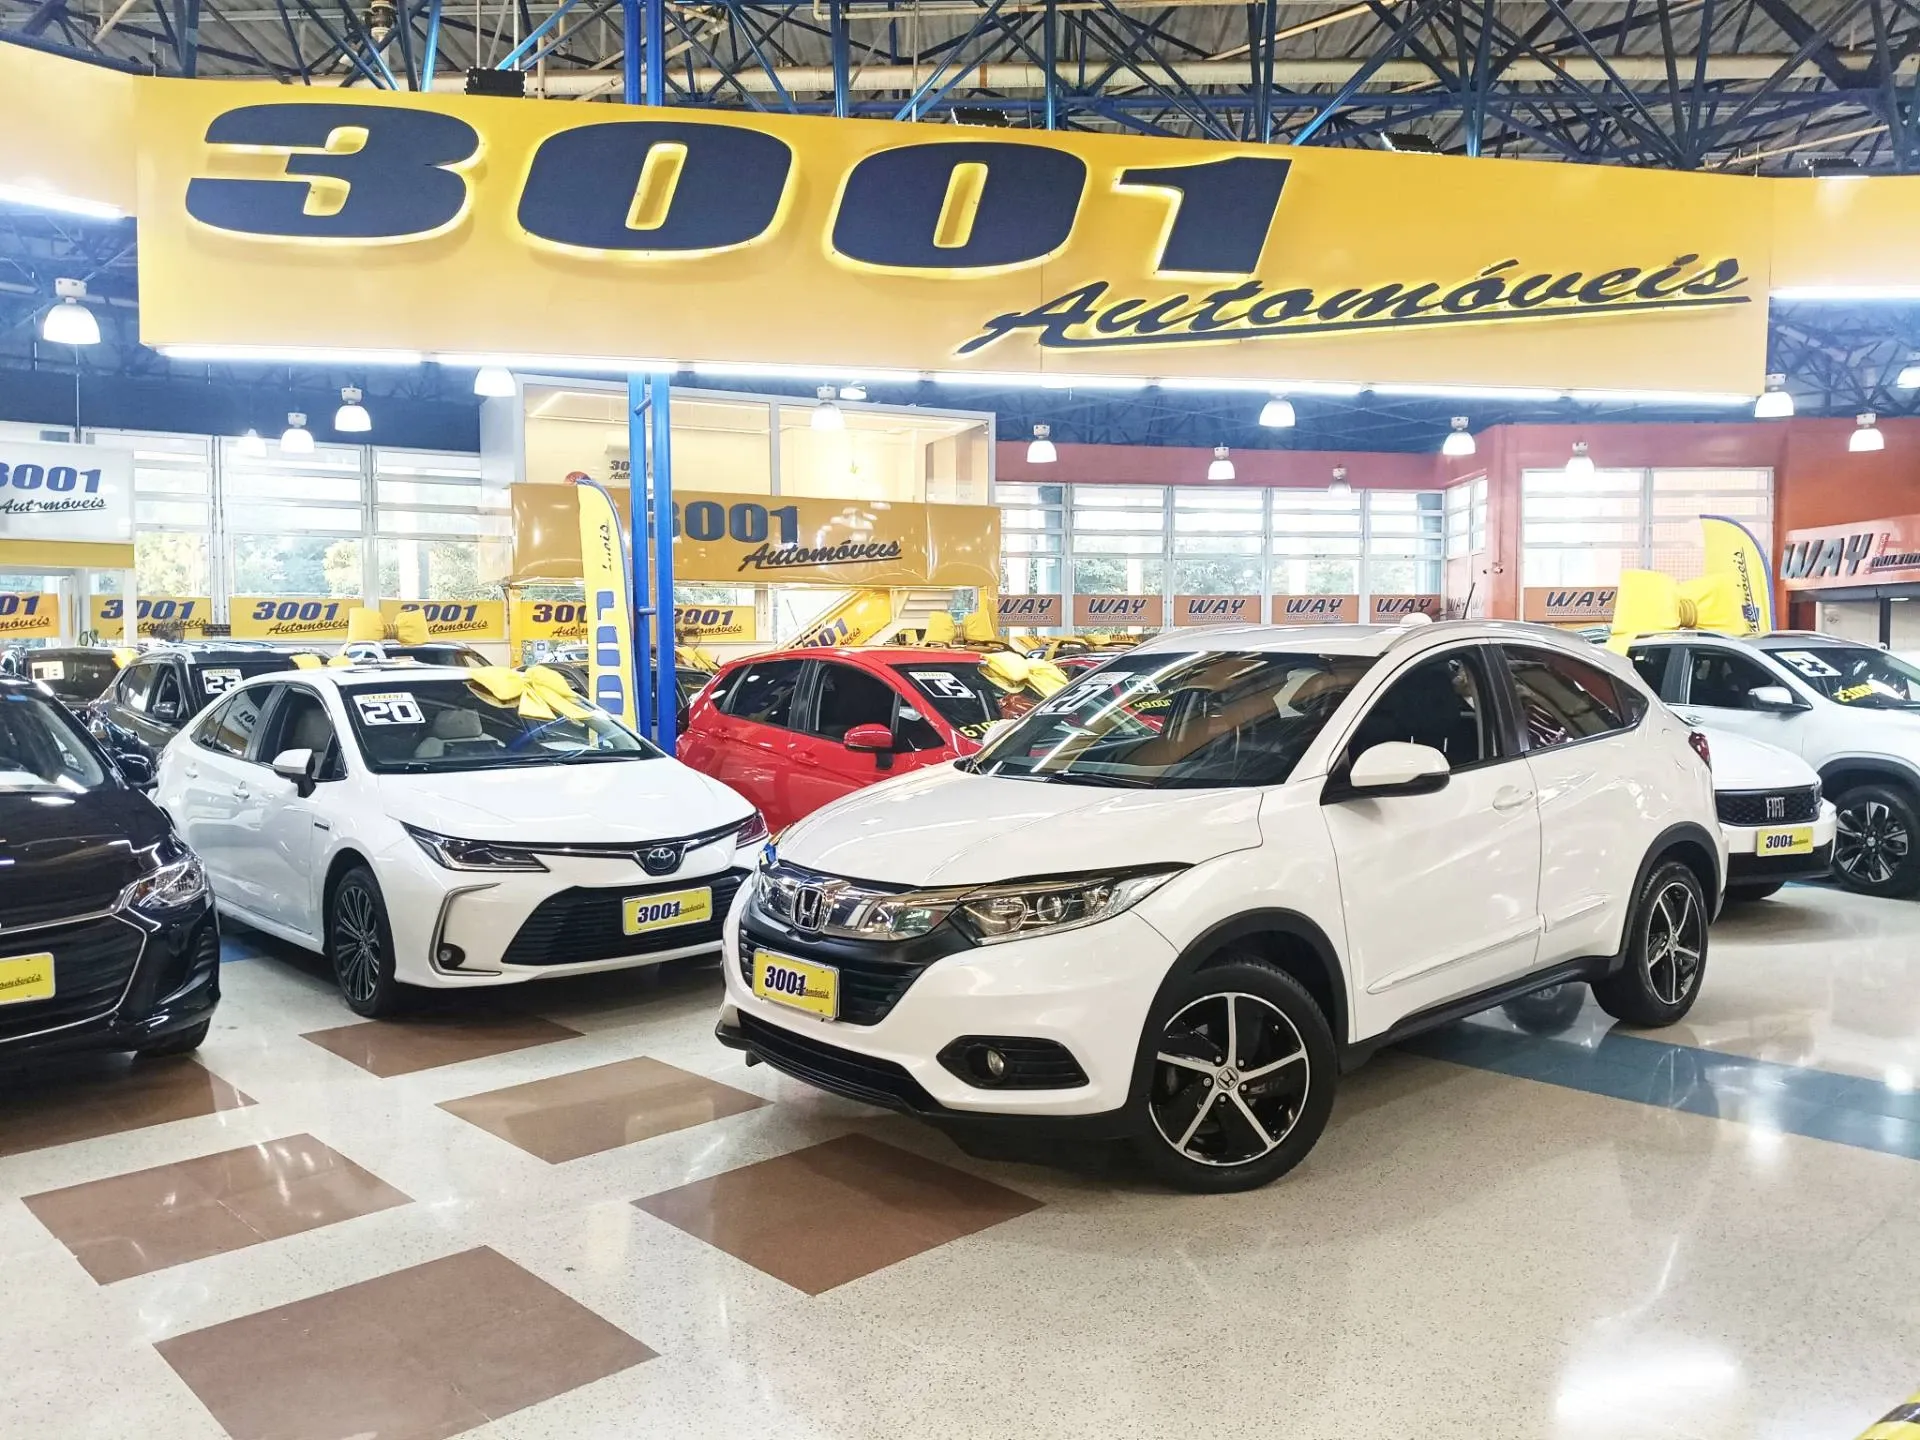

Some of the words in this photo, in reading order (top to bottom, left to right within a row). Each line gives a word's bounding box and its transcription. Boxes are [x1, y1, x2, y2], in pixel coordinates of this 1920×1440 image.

[185, 103, 1292, 275] 3001
[957, 255, 1751, 355] Automóveis
[738, 539, 902, 572] Automóveis
[1782, 533, 1874, 578] WAY
[0, 595, 40, 615] 01
[1088, 599, 1147, 613] WAY
[1189, 599, 1246, 613] WAY
[1286, 599, 1343, 612] WAY
[1376, 599, 1432, 612] WAY
[1546, 591, 1615, 606] WAY
[253, 601, 340, 620] 3001
[533, 604, 587, 623] 300
[0, 616, 50, 631] móveis
[360, 701, 423, 723] 20
[1765, 797, 1785, 818] FIAT
[1766, 835, 1793, 849] 3001
[637, 901, 681, 923] 3001
[765, 966, 806, 996] 3001
